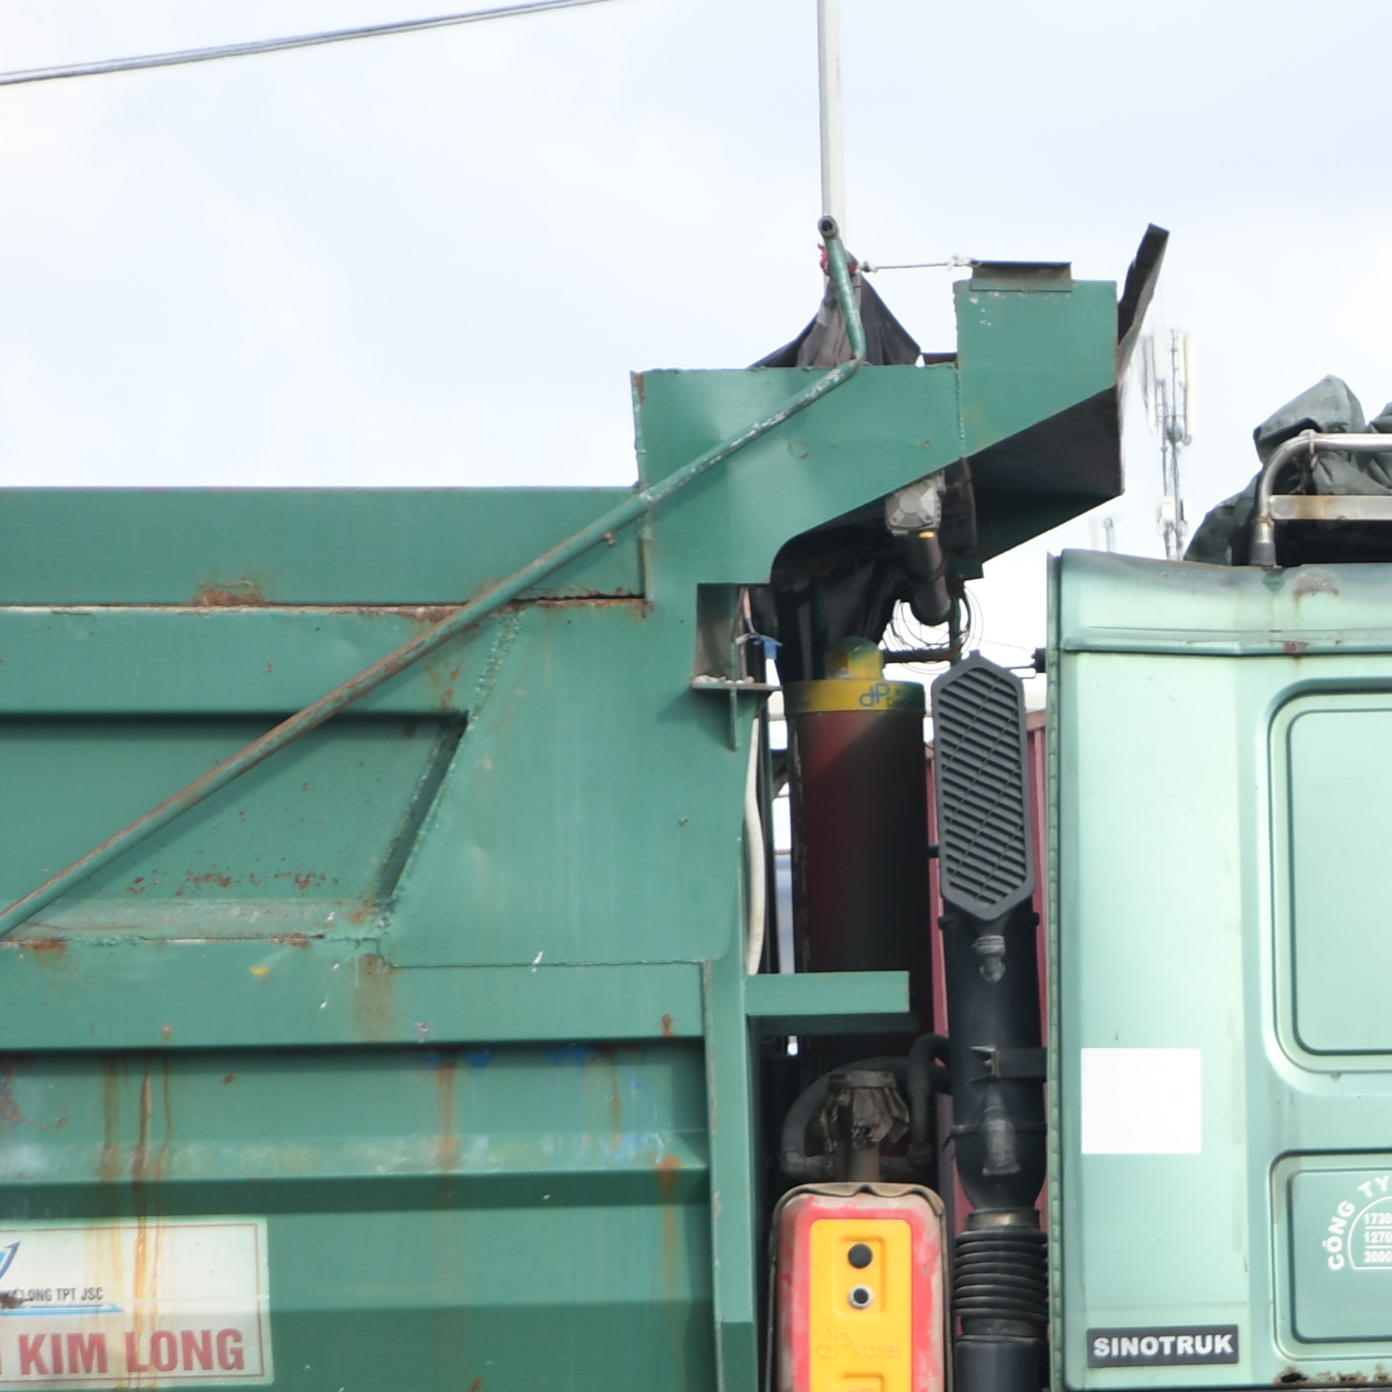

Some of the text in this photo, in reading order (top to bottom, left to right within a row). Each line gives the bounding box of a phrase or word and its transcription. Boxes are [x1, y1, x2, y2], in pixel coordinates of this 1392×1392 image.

[1321, 1200, 1356, 1270] CÔNG
[1357, 1175, 1390, 1198] TY
[56, 1287, 77, 1302] TPT
[80, 1286, 104, 1301] JSC
[18, 1328, 246, 1376] KIM LONG
[1092, 1332, 1234, 1358] SINOTRUK
